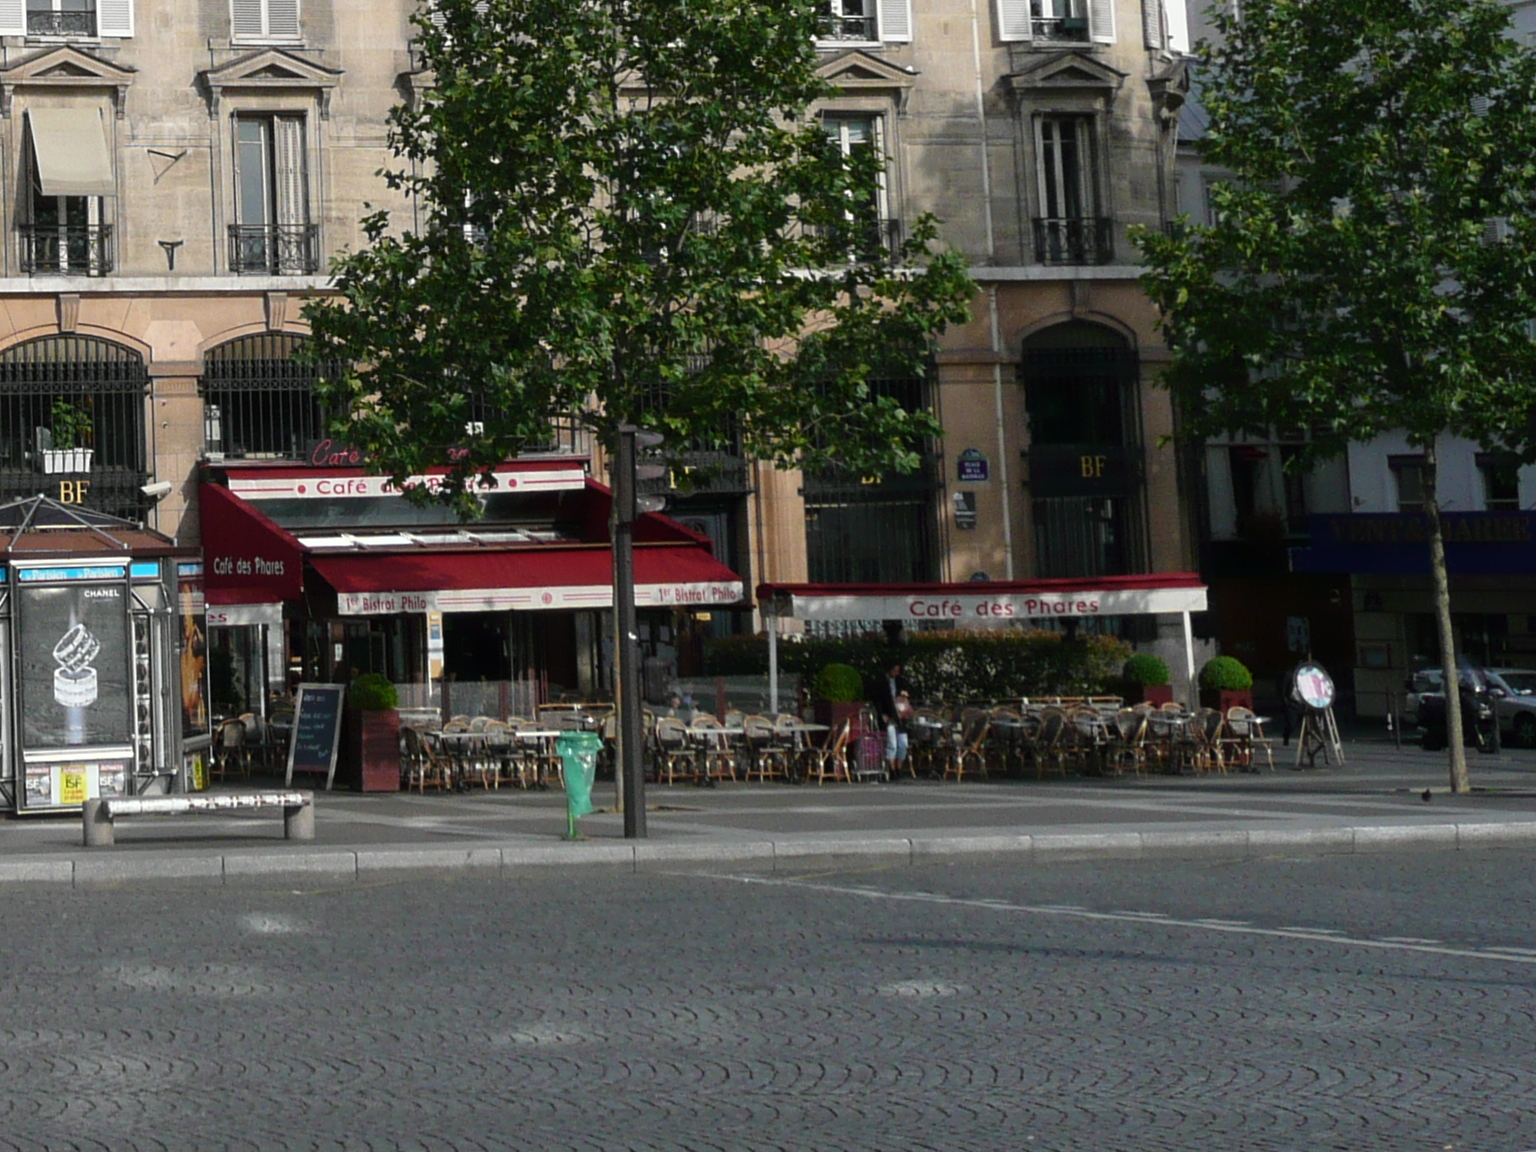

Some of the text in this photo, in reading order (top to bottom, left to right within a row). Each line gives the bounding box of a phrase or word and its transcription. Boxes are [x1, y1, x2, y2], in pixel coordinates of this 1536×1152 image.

[1080, 455, 1107, 477] BF
[59, 480, 91, 504] BF
[316, 479, 367, 495] Café
[213, 556, 233, 574] Café
[236, 557, 252, 575] des
[254, 556, 284, 575] Phares
[84, 589, 120, 598] CHANEL
[675, 587, 706, 602] Bistrot
[712, 586, 736, 600] Philo
[363, 597, 395, 611] Bistrot
[401, 595, 427, 610] Philo
[909, 599, 1099, 617] Café des Phares
